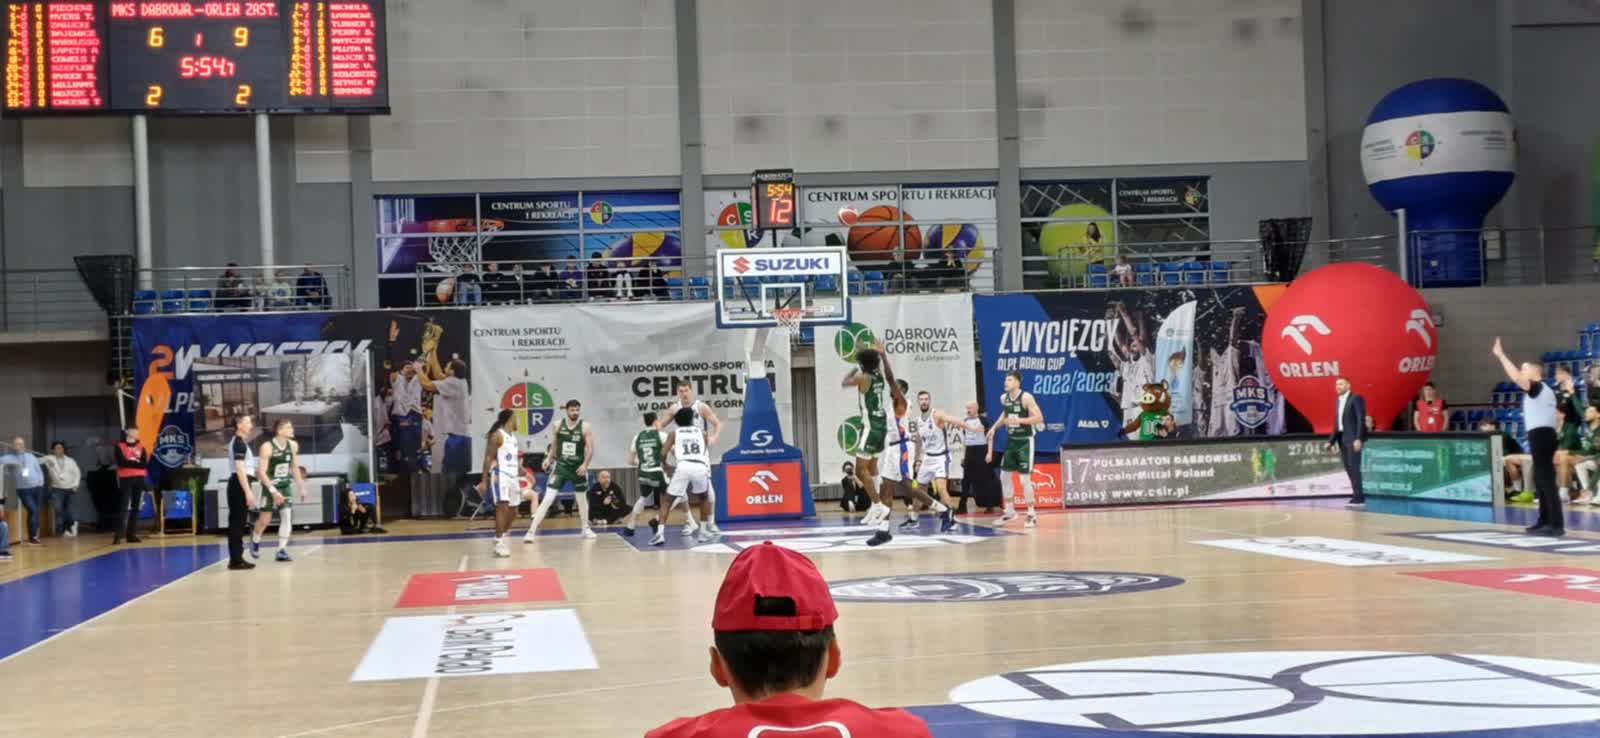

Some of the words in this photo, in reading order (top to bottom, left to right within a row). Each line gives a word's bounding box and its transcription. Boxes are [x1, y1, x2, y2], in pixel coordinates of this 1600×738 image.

[111, 3, 135, 16] MKS
[149, 27, 164, 47] 6
[234, 27, 249, 47] 9
[147, 85, 163, 106] 2
[235, 84, 251, 105] 2
[808, 191, 868, 202] CENTRUM
[872, 188, 926, 201] SPORTU
[491, 202, 534, 210] CENTRUM
[770, 199, 793, 223] 12
[726, 213, 738, 225] C
[754, 257, 829, 271] SUZUKI
[473, 328, 520, 336] CENTRUM
[523, 327, 561, 335] SPORTU
[998, 318, 1121, 358] ZWYCIĘZCY
[590, 364, 620, 374] HALA
[997, 358, 1017, 371] ALPE
[1019, 357, 1046, 370] ADRIA
[1047, 357, 1066, 371] CUP
[1280, 361, 1340, 378] ORLEN
[1033, 369, 1114, 395] 2022/2023
[511, 394, 523, 407] C
[532, 393, 543, 406] S
[1235, 388, 1265, 399] MKS
[637, 402, 648, 411] W
[532, 413, 544, 425] R
[159, 434, 185, 445] MKS
[682, 443, 700, 456] 18
[1065, 458, 1091, 484] 17
[1174, 467, 1215, 479] Poland
[746, 494, 784, 505] ORLEN
[1066, 489, 1107, 502] zapisy
